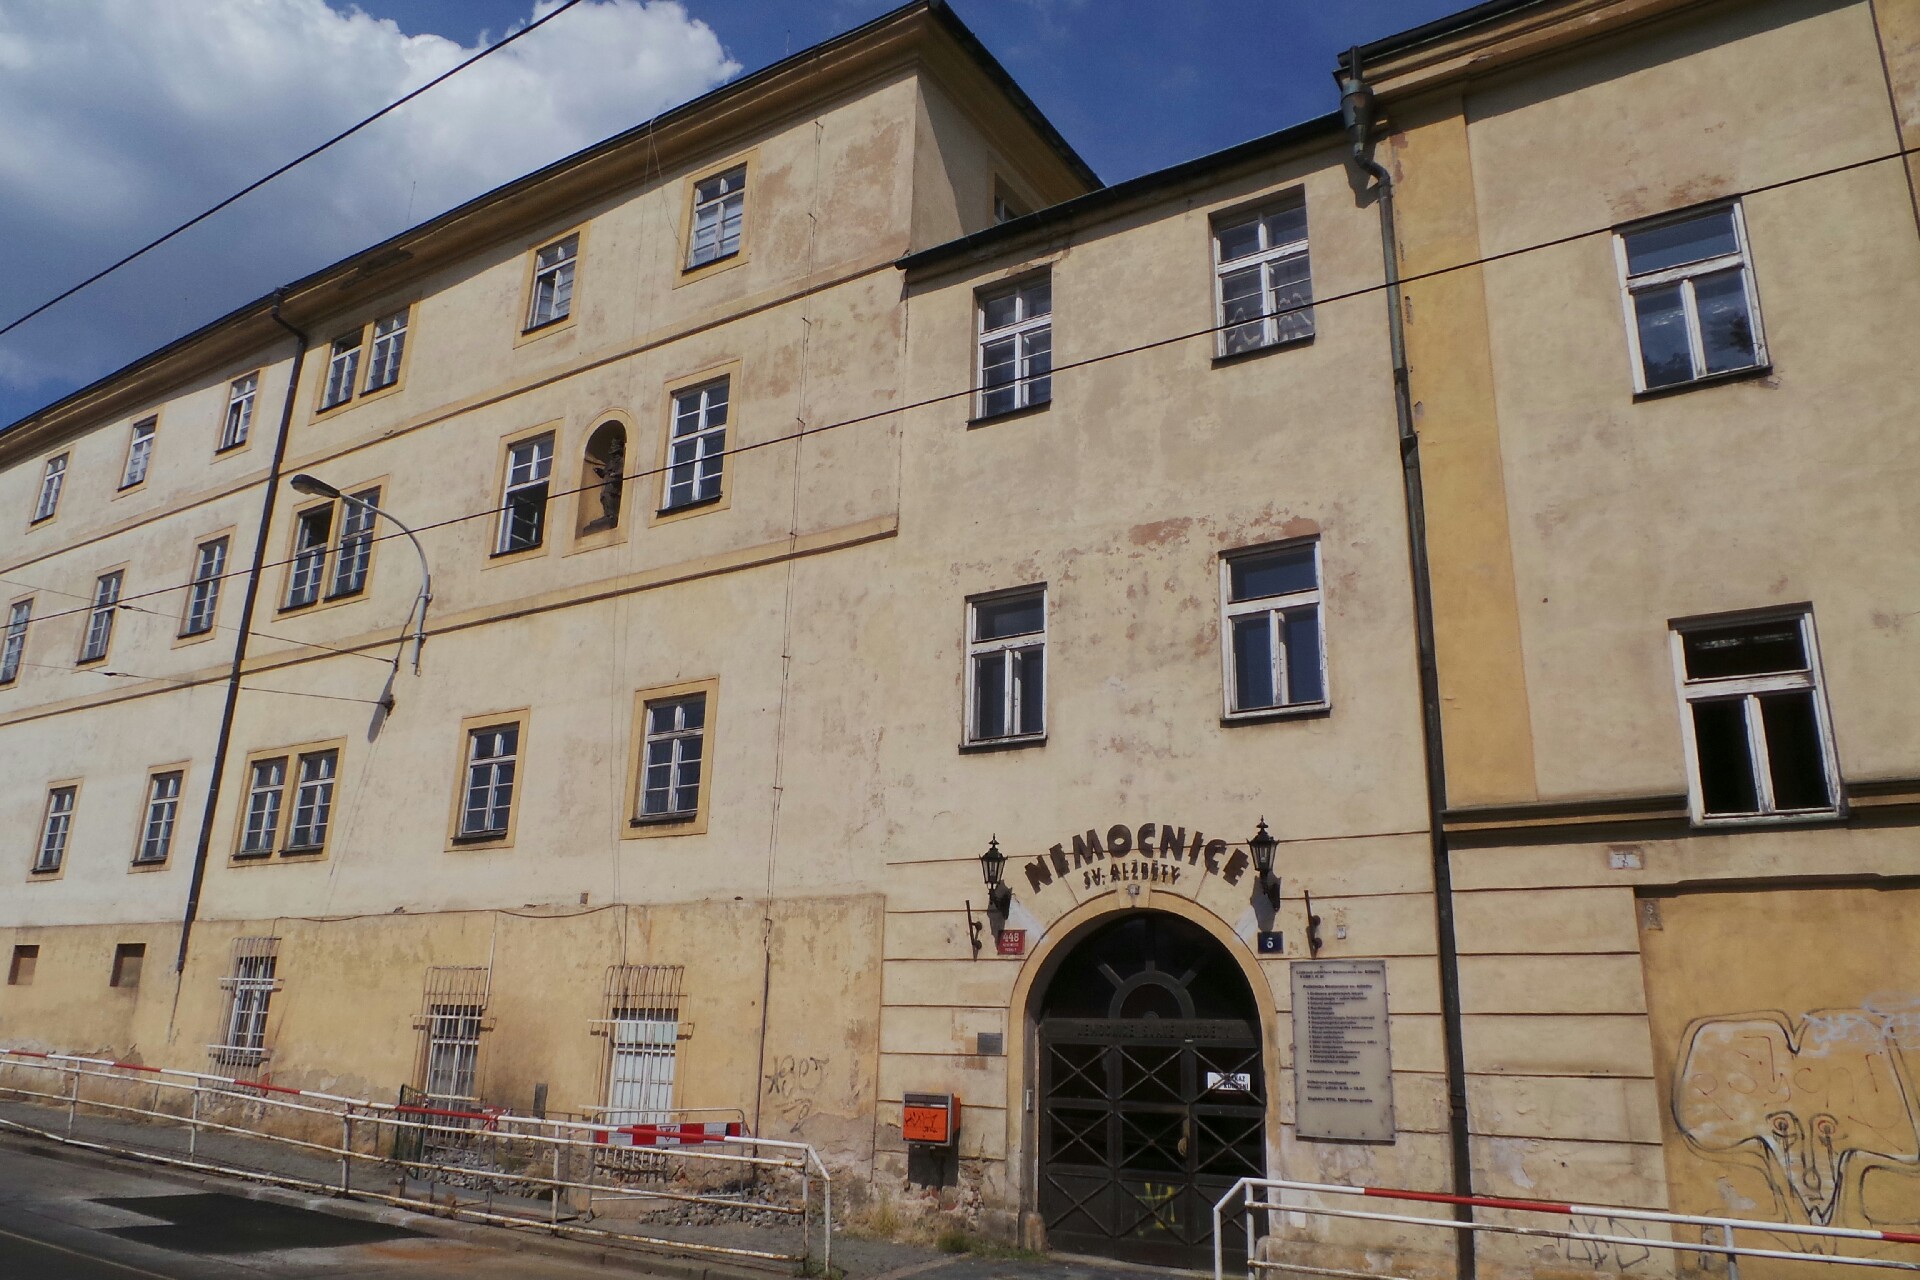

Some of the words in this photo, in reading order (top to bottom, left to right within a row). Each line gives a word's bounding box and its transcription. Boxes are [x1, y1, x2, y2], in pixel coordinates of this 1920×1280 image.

[1025, 822, 1250, 894] NEMOCNICE
[1110, 858, 1181, 886] ALŽBĚTY
[1003, 932, 1020, 943] 448
